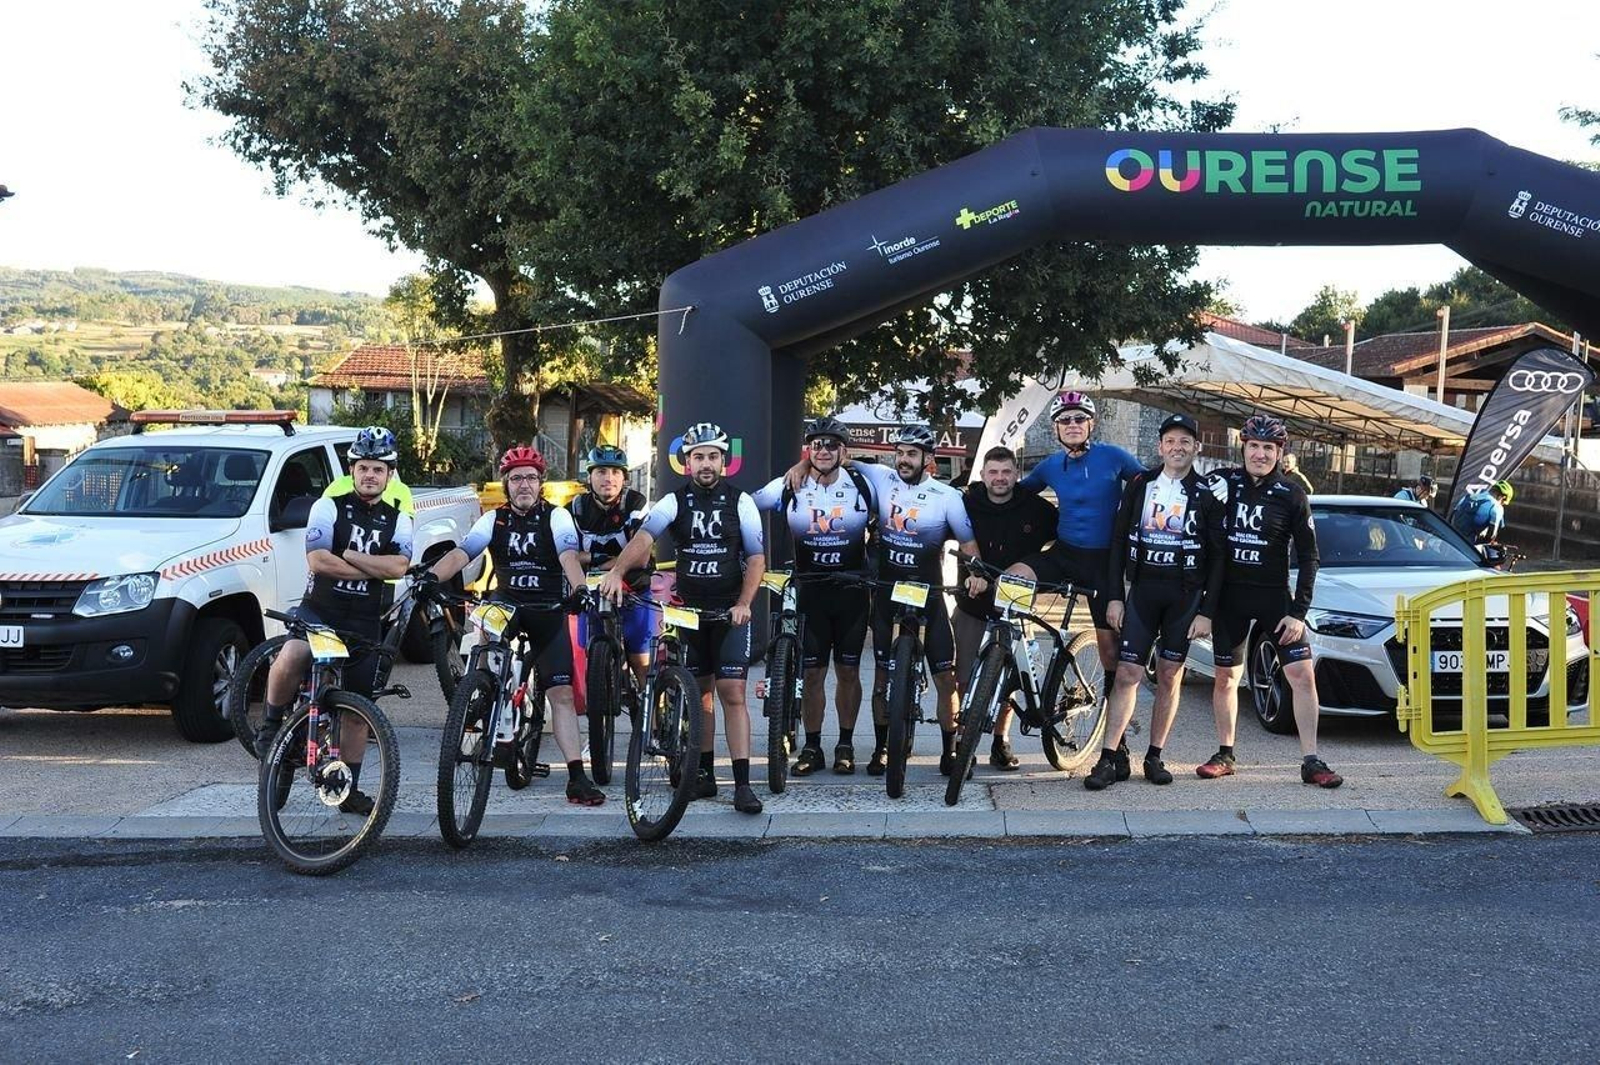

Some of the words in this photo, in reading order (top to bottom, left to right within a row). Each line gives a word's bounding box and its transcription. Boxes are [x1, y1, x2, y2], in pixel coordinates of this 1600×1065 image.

[1105, 147, 1422, 194] OURENSE
[974, 199, 1018, 224] DEPORTE
[1304, 199, 1419, 218] NATURAL
[1534, 201, 1600, 231] DEPUTACIÓ
[1529, 212, 1585, 238] OURENSE
[883, 235, 916, 255] inorde
[913, 239, 941, 256] Ourense
[778, 260, 847, 295] DEPUTACIÓN
[783, 278, 834, 305] OURENSE
[1001, 407, 1030, 446] rsa
[813, 552, 841, 564] TCR
[889, 549, 915, 565] TCR
[1146, 550, 1176, 563] TCR
[1234, 548, 1260, 561] TCR
[690, 561, 718, 574] TCR
[0, 629, 20, 644] JJ
[1438, 654, 1464, 670] 90
